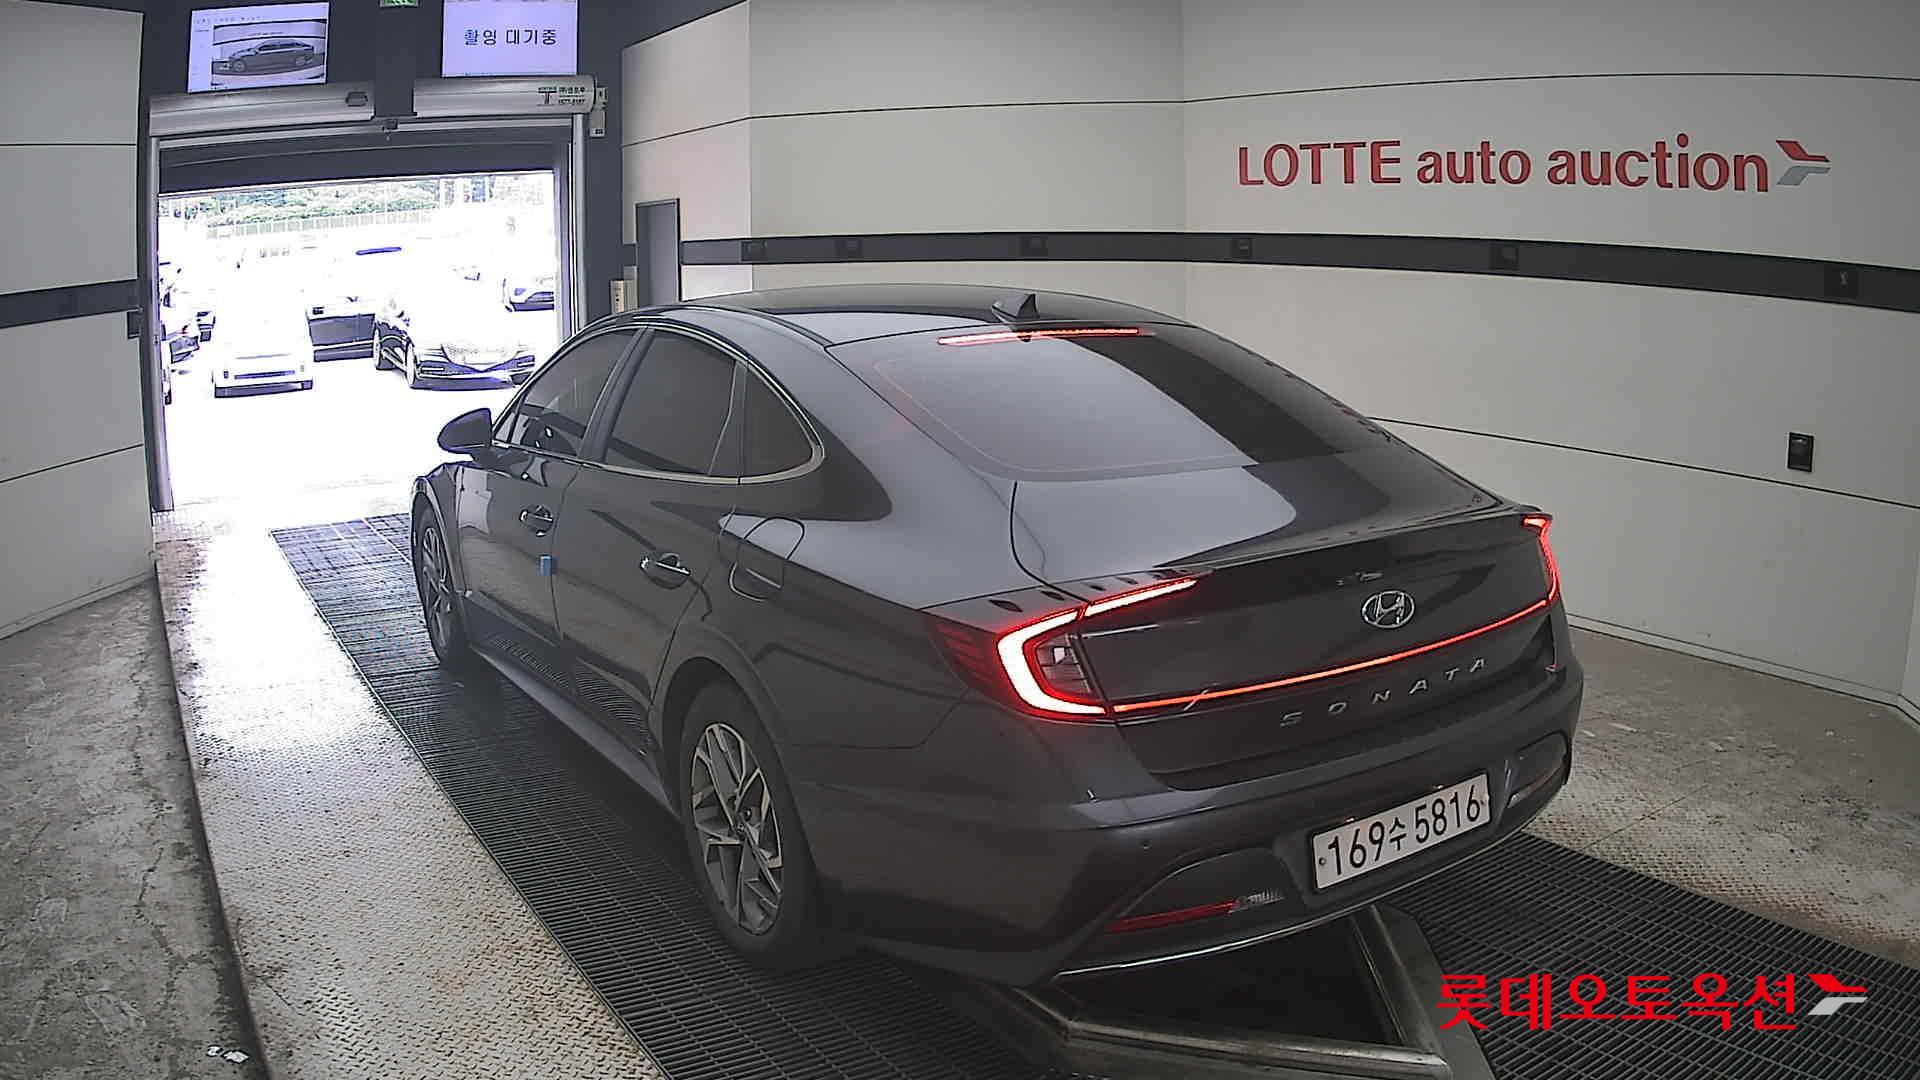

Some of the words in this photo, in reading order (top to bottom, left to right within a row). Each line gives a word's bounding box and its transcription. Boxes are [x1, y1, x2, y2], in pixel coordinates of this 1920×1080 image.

[464, 29, 497, 46] 촬영
[505, 29, 556, 46] 대기중
[1238, 140, 1401, 187] LOTTE
[1416, 140, 1532, 185] auto
[1548, 132, 1769, 193] auction
[1279, 656, 1487, 728] SONATA
